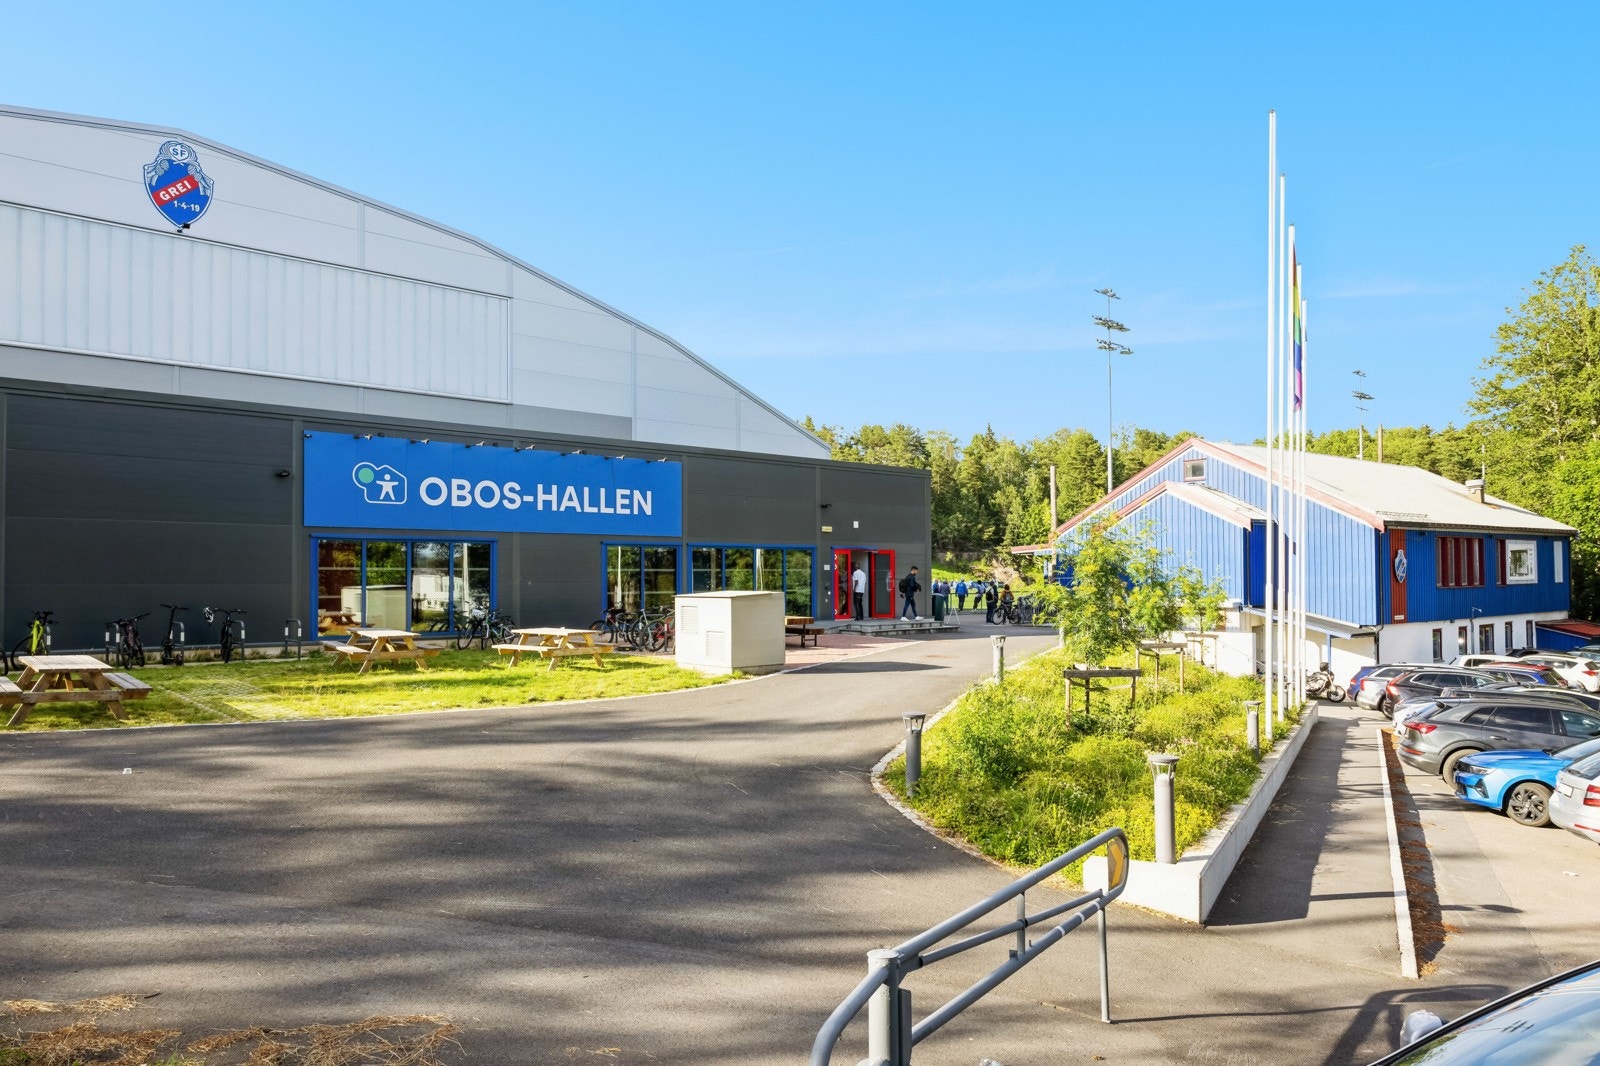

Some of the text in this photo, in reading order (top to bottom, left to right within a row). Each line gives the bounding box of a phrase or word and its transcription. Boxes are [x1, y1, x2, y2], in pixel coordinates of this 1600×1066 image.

[159, 180, 192, 201] GREI
[173, 200, 200, 211] 1-4-19
[419, 476, 652, 516] OBOS-HALLEN
